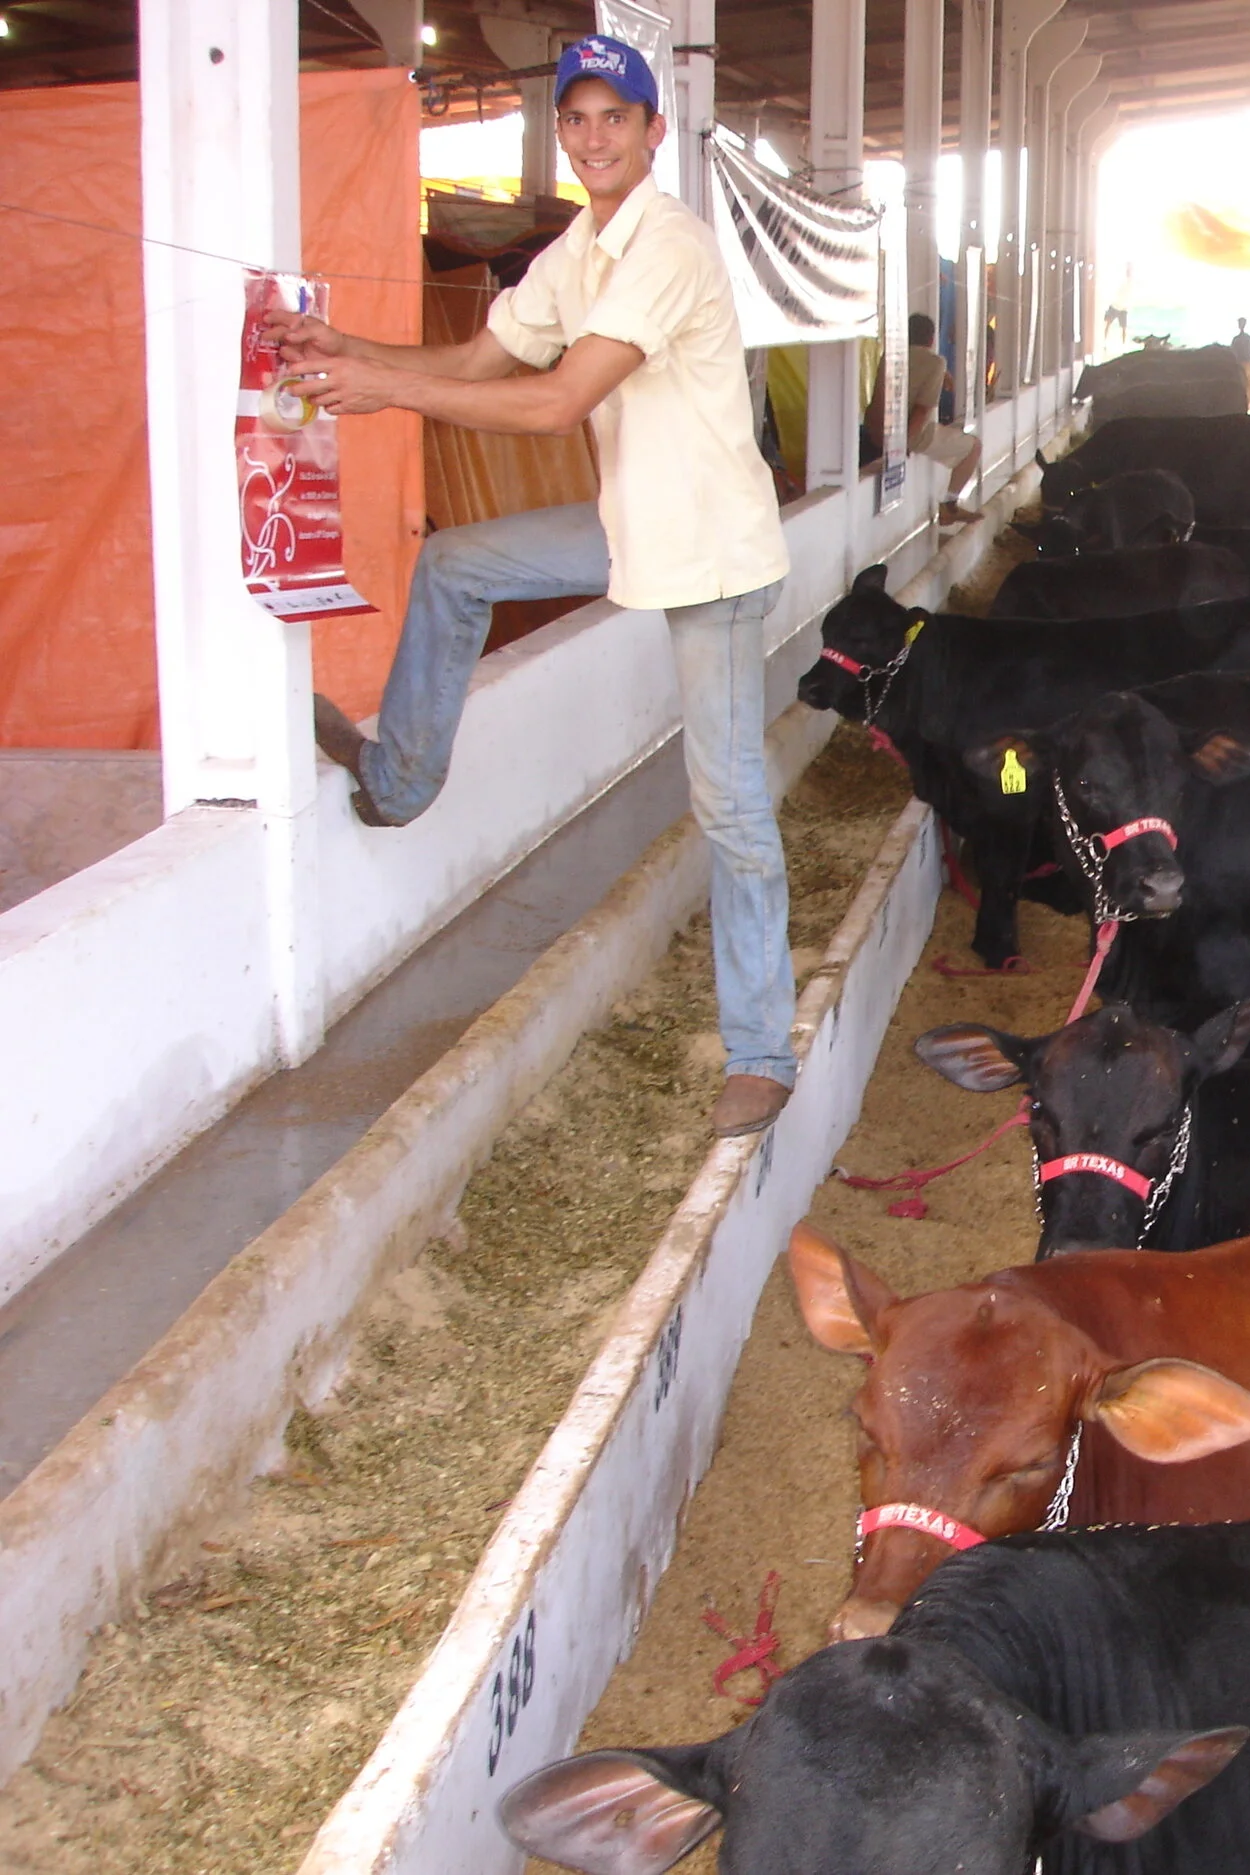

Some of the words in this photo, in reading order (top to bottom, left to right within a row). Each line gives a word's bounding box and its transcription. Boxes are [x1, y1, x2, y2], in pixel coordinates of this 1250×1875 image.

[580, 57, 626, 75] TEXAS
[1081, 1154, 1125, 1179] TEXAS
[898, 1504, 957, 1539] TEXAS
[488, 1608, 536, 1777] 388
